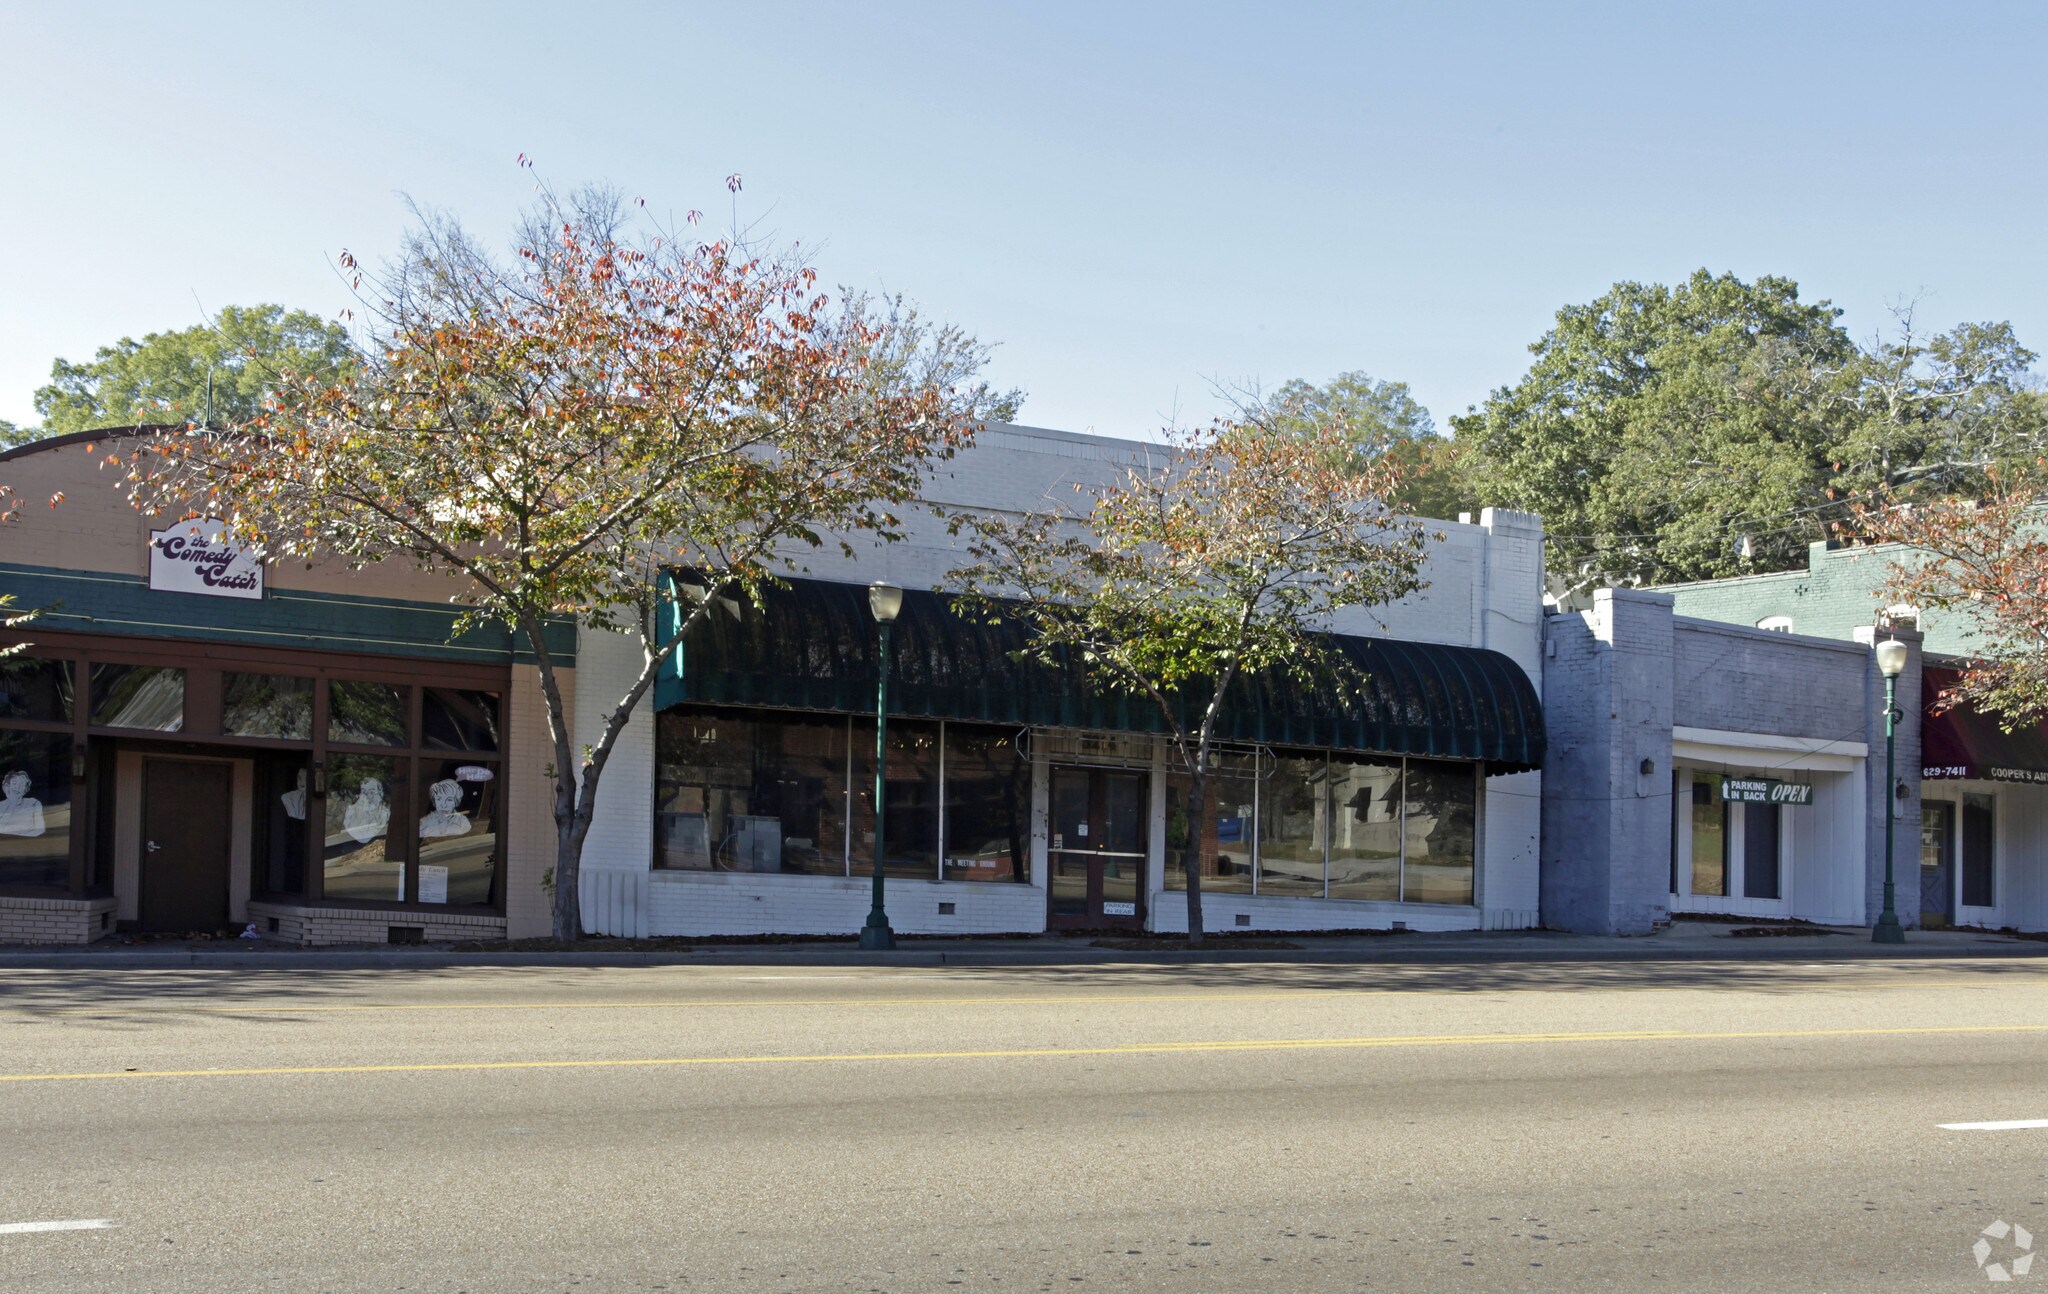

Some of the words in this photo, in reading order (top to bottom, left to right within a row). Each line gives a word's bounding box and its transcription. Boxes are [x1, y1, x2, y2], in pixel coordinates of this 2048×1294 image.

[191, 536, 209, 548] the
[155, 537, 237, 574] Comedy
[195, 565, 259, 590] Catch
[1923, 767, 1966, 777] 629-7411
[1991, 767, 2031, 779] COOPER'S
[1731, 781, 1767, 791] PARKING
[1771, 784, 1810, 802] OPEN
[1731, 791, 1739, 799] IN
[1744, 792, 1766, 801] BACK
